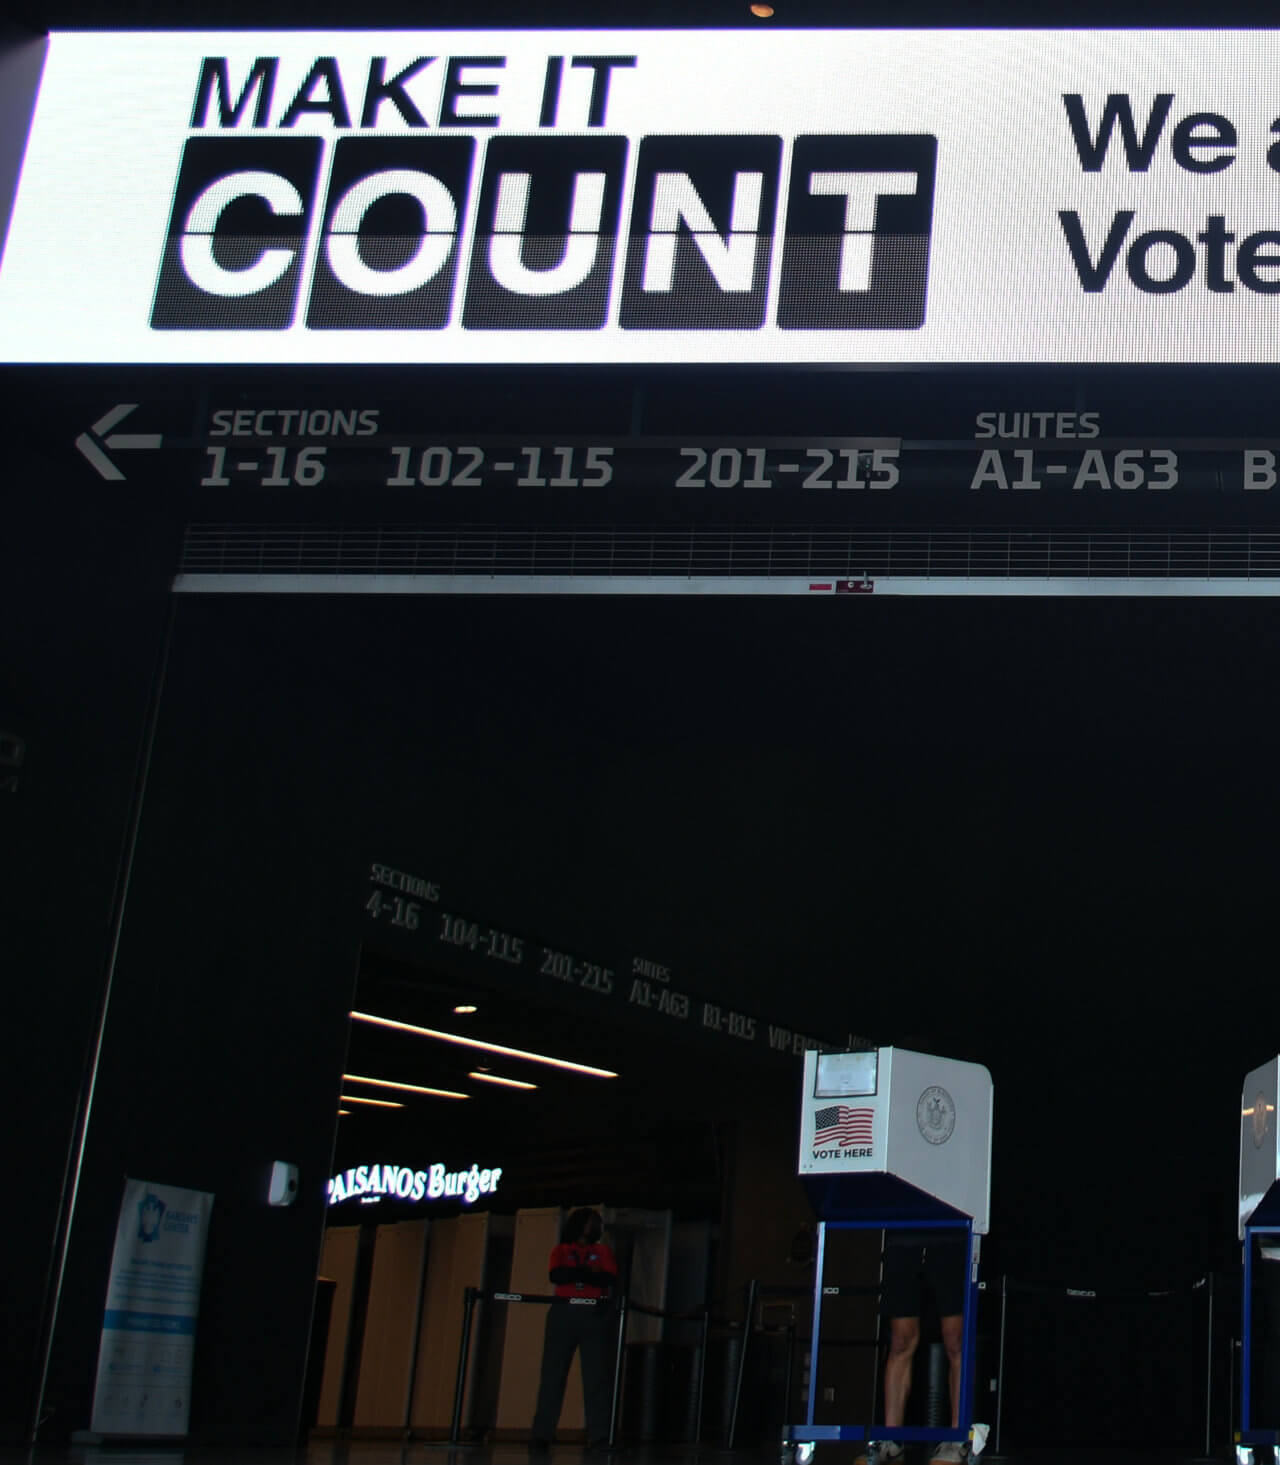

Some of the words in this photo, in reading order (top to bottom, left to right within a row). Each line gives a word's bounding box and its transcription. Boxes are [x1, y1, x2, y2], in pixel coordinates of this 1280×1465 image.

[191, 55, 504, 129] MAKE
[539, 55, 638, 128] IT
[1062, 92, 1238, 174] We
[179, 169, 919, 297] COUNT
[210, 408, 380, 437] SECTIONS
[974, 411, 1101, 440] SUITES
[200, 446, 327, 488] 1-16
[386, 446, 614, 489] 102-115
[674, 447, 902, 490] 201-215
[970, 450, 1180, 491] A1-A63
[369, 863, 441, 903] SECTIONS
[365, 889, 422, 931] 4-16
[439, 912, 525, 965] 104-115
[539, 947, 616, 996] 201-215
[629, 978, 690, 1020] A1-A63
[767, 1024, 792, 1052] VIP
[632, 956, 671, 984] SUITES
[812, 1150, 841, 1160] VOTE
[844, 1147, 873, 1159] HERE
[427, 1161, 504, 1204] Burger
